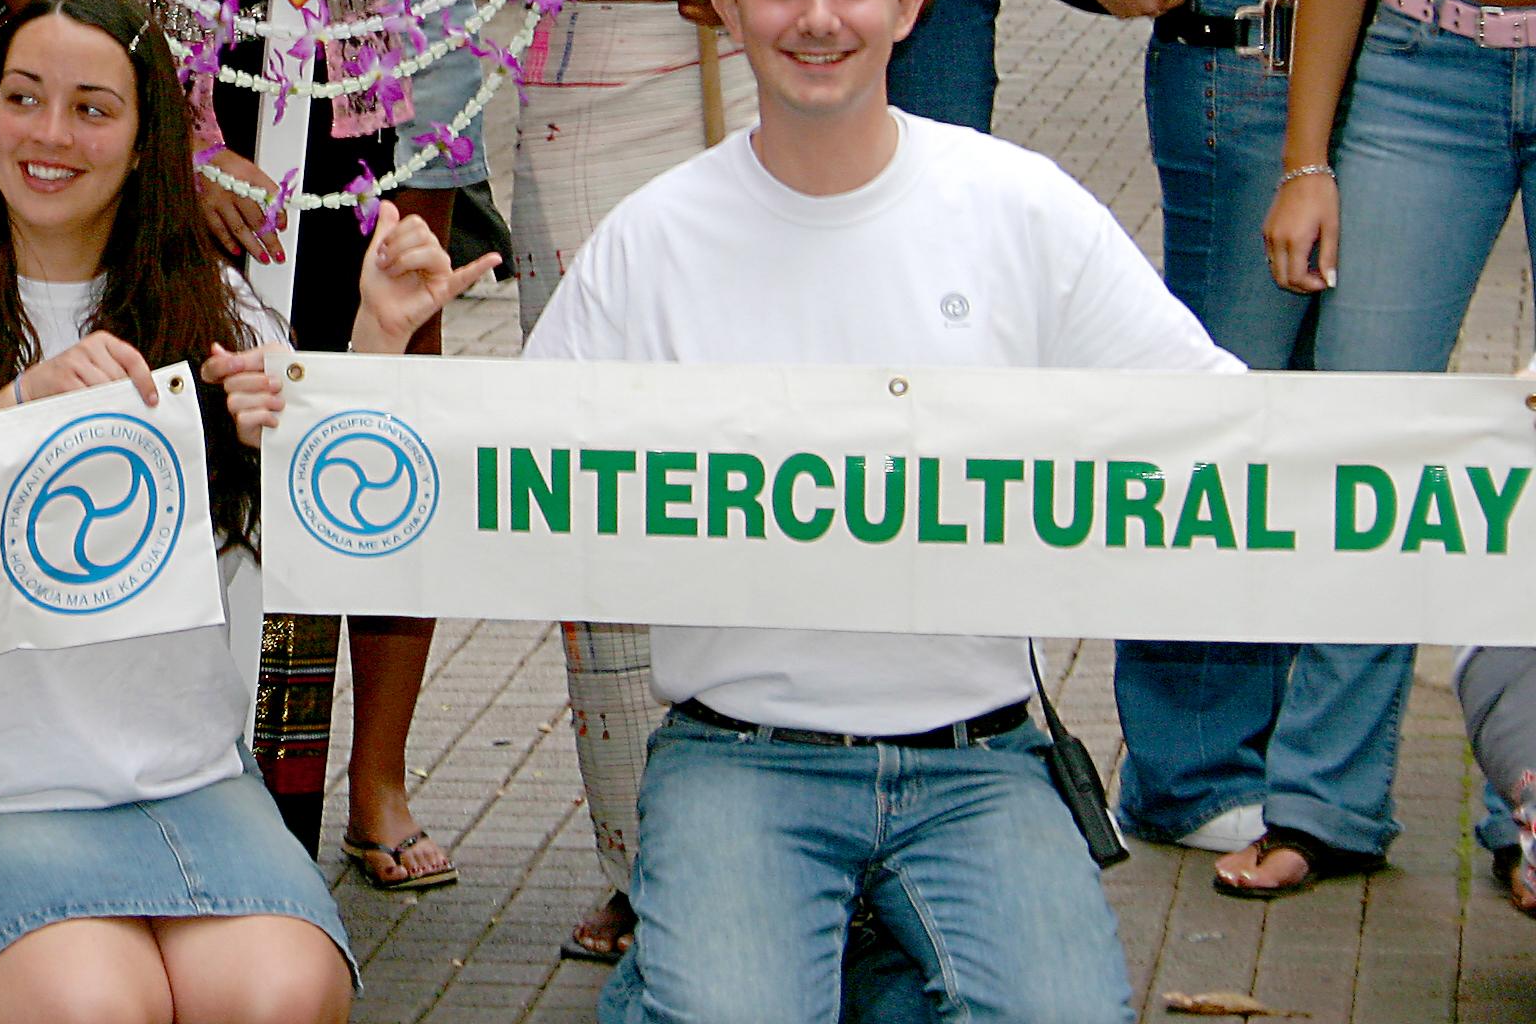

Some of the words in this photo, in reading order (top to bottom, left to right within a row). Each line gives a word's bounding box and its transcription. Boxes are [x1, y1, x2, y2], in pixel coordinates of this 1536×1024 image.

[322, 418, 373, 438] PACIFIC
[45, 426, 105, 466] PACIFIC
[111, 426, 174, 493] UNIVERSITY
[477, 447, 1295, 550] INTERCULTURAL
[1335, 465, 1529, 553] DAY
[118, 575, 138, 594] KA
